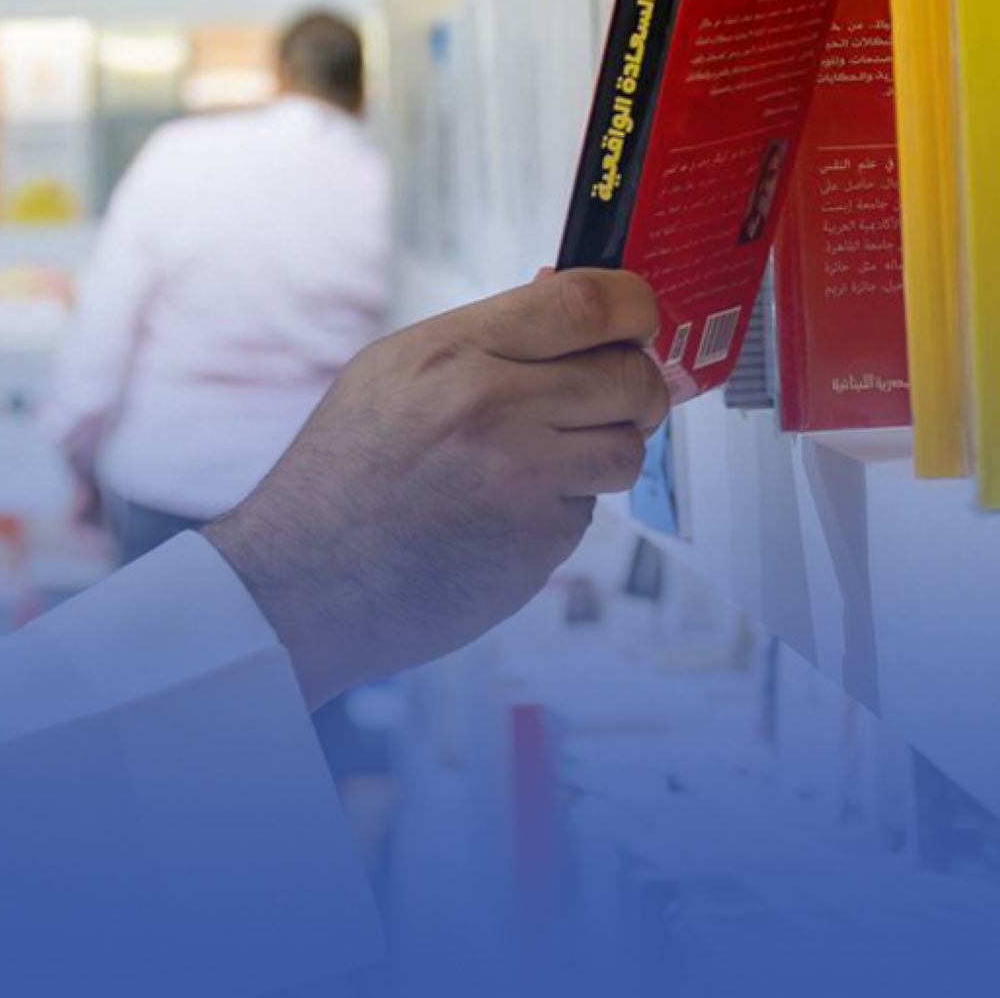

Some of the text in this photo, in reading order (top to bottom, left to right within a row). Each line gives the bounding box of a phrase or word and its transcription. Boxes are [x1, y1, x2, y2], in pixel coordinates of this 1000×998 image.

[591, 95, 635, 201] الواقعية
[819, 158, 851, 175] النفس
[875, 376, 910, 393] صرية
